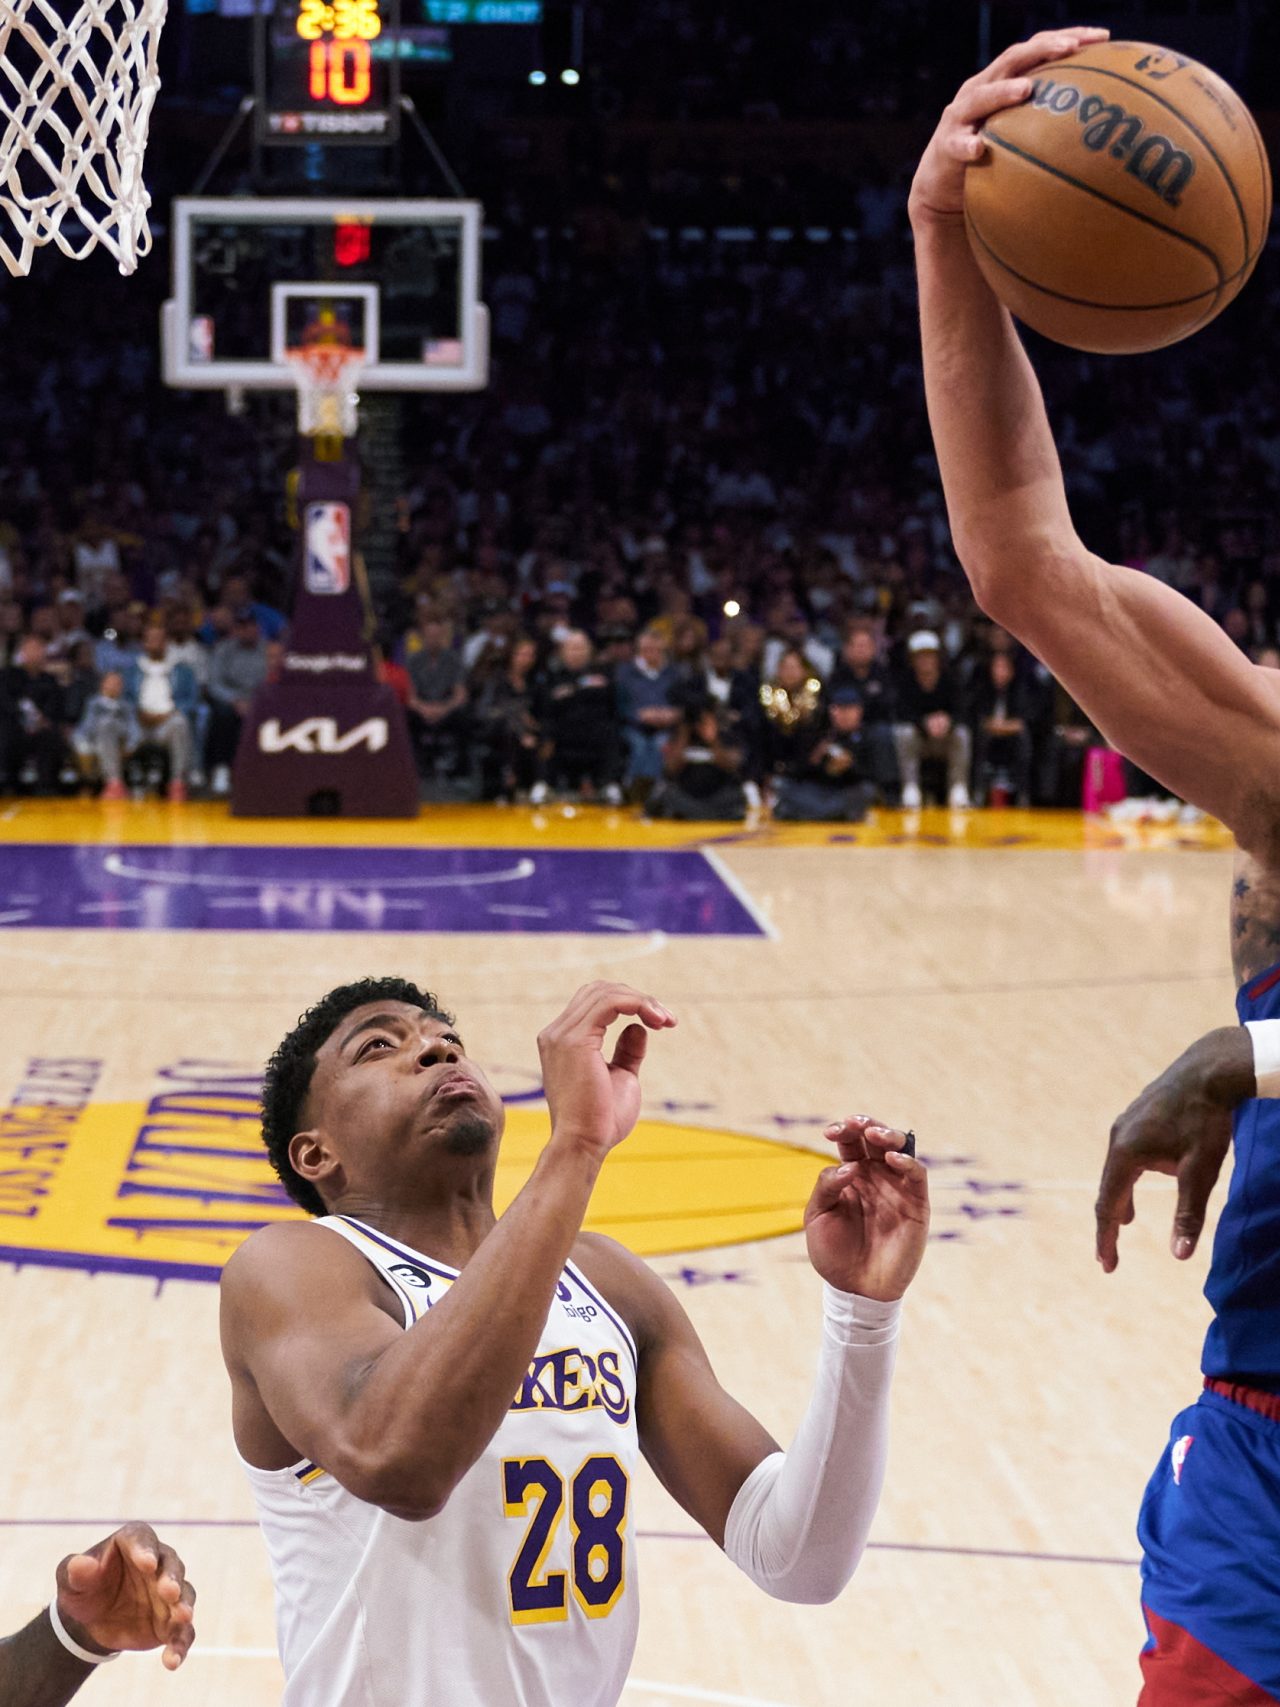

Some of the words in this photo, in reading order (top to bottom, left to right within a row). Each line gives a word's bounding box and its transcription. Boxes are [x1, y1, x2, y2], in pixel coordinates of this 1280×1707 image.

[310, 39, 371, 104] 10
[1032, 80, 1193, 206] Wilson
[561, 1303, 598, 1323] bigo
[500, 1452, 631, 1627] 28
